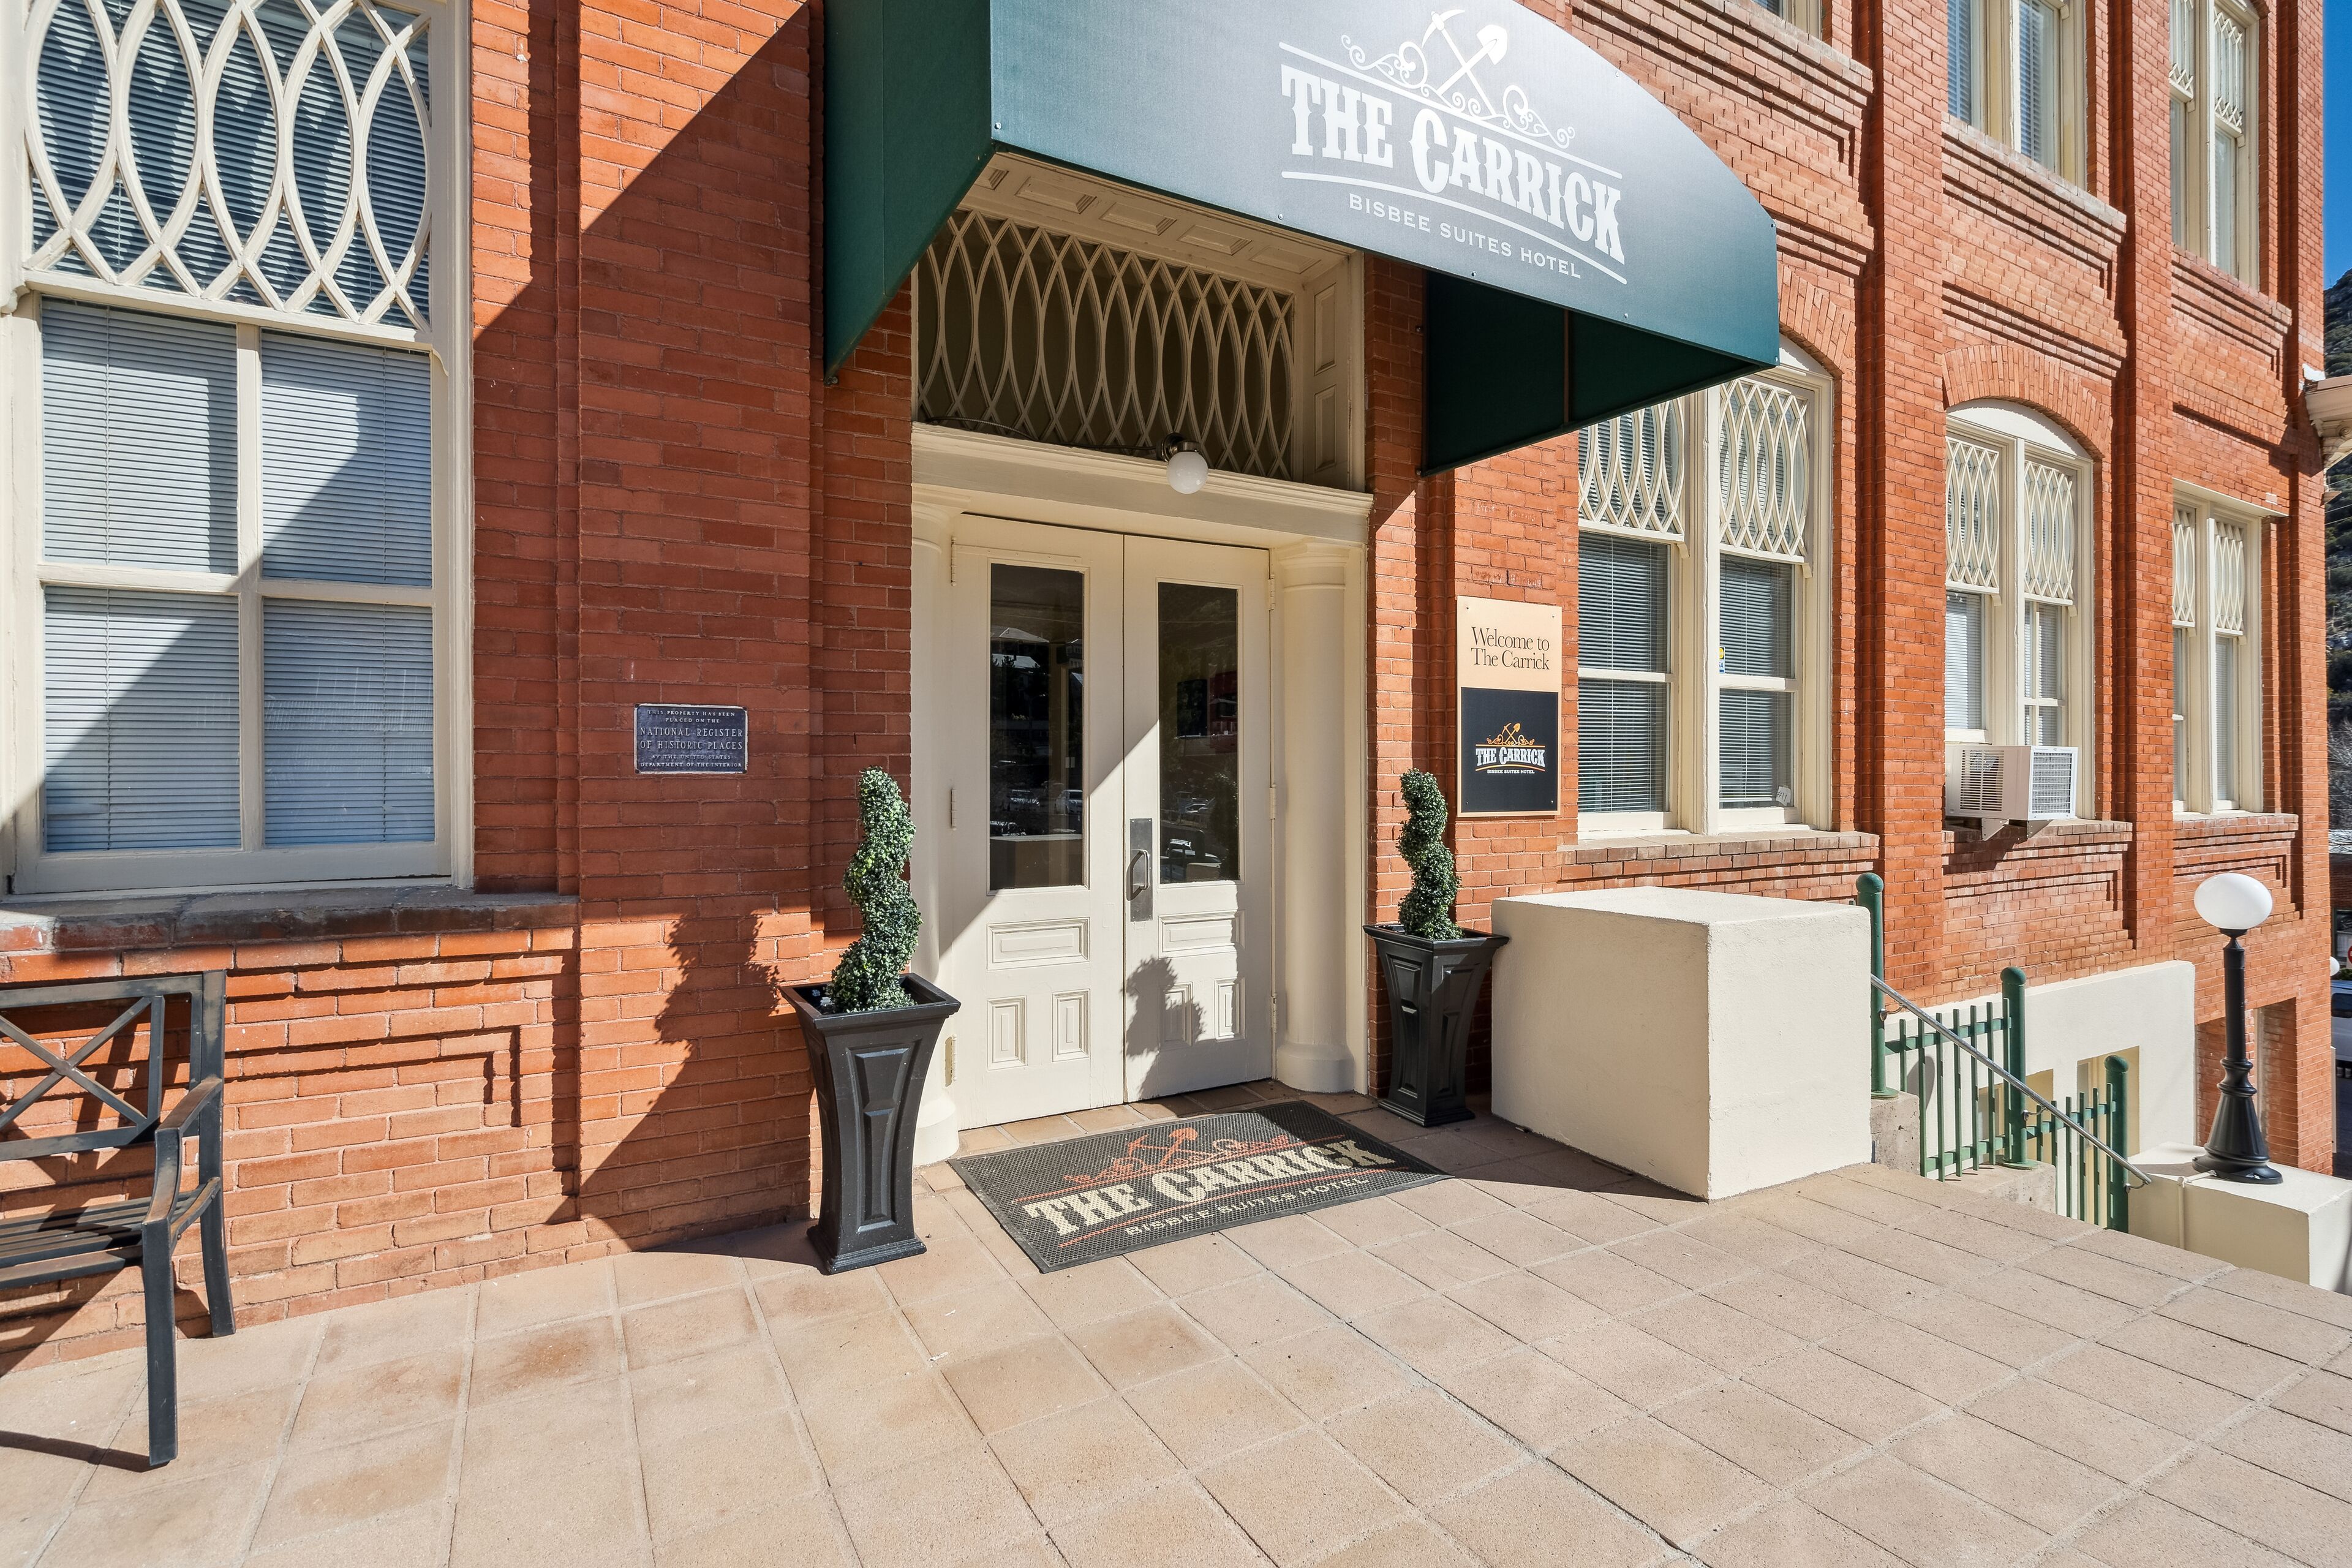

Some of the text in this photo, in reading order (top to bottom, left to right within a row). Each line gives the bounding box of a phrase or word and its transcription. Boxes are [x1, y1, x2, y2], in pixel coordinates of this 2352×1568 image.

[1281, 64, 1626, 265] THE CARRICK
[1349, 193, 1581, 279] BISBEE SUITES HOTEL
[1471, 626, 1550, 652] Welcome to
[1471, 647, 1550, 670] The Carrick
[640, 727, 742, 737] NATIONAL REGISTER
[640, 740, 742, 750] OF HISTORIC PLACES
[1475, 747, 1545, 767] THE CARRICK
[1022, 1139, 1396, 1236] THE CARRICK
[1124, 1177, 1370, 1236] BISBEE SUITES HOTEL
